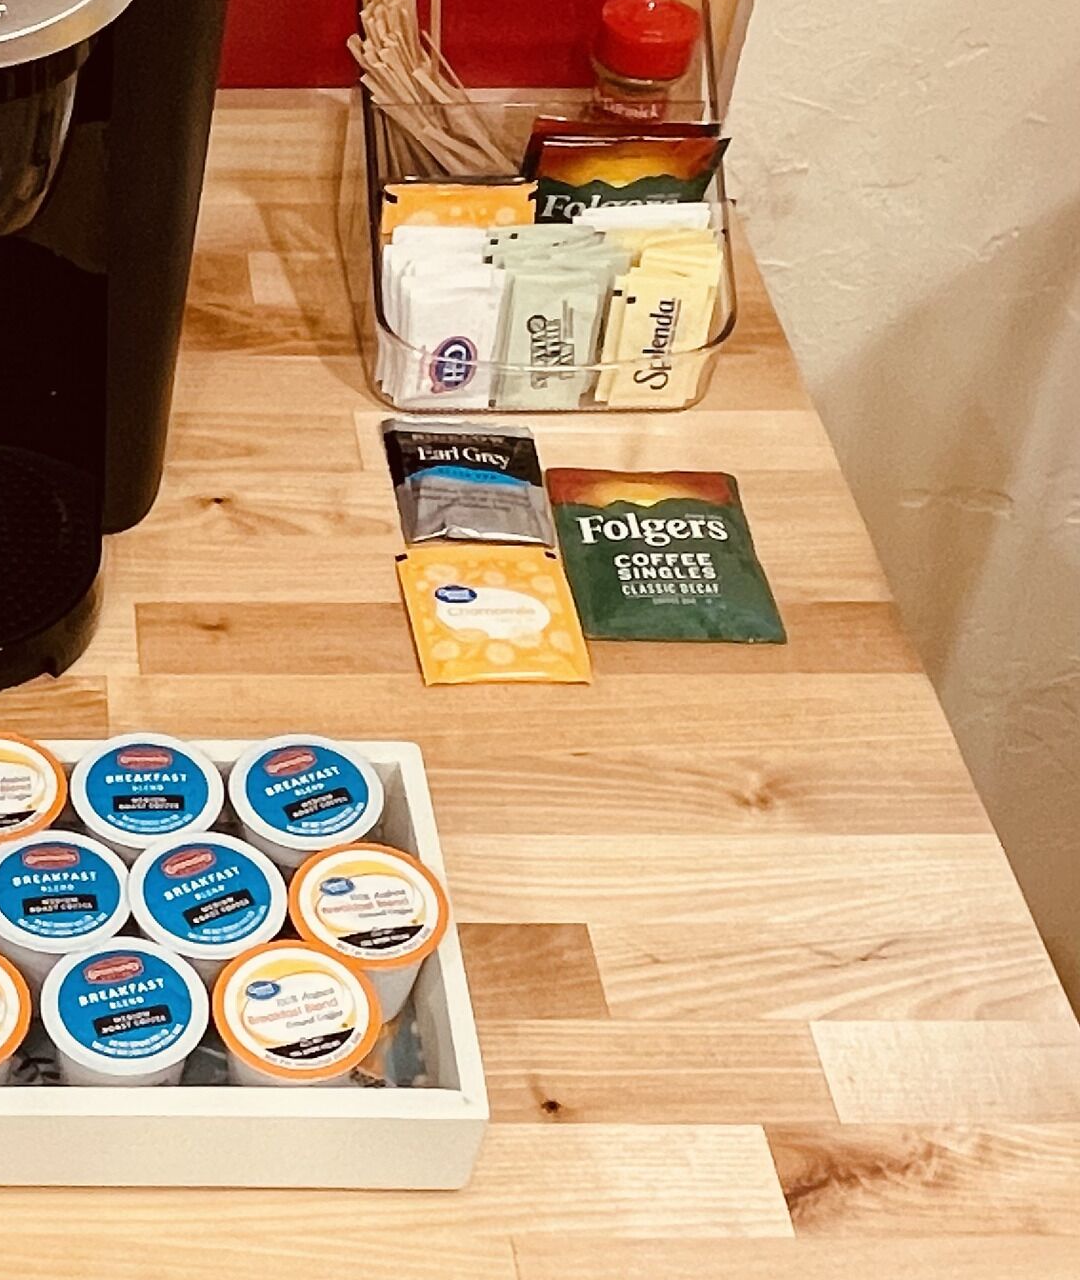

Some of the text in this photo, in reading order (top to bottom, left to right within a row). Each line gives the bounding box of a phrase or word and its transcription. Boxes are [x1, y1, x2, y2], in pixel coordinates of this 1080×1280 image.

[417, 446, 511, 469] Earl Grey
[576, 512, 729, 547] Folgers
[614, 552, 713, 568] COFFEE
[618, 566, 716, 580] SINGLES
[105, 773, 188, 784] BREAKFAST
[264, 766, 340, 796] BREAKFAST
[12, 870, 97, 887] BREAKFAST
[163, 866, 240, 901] BREAKFAST
[78, 977, 165, 1008] BREAKFAST
